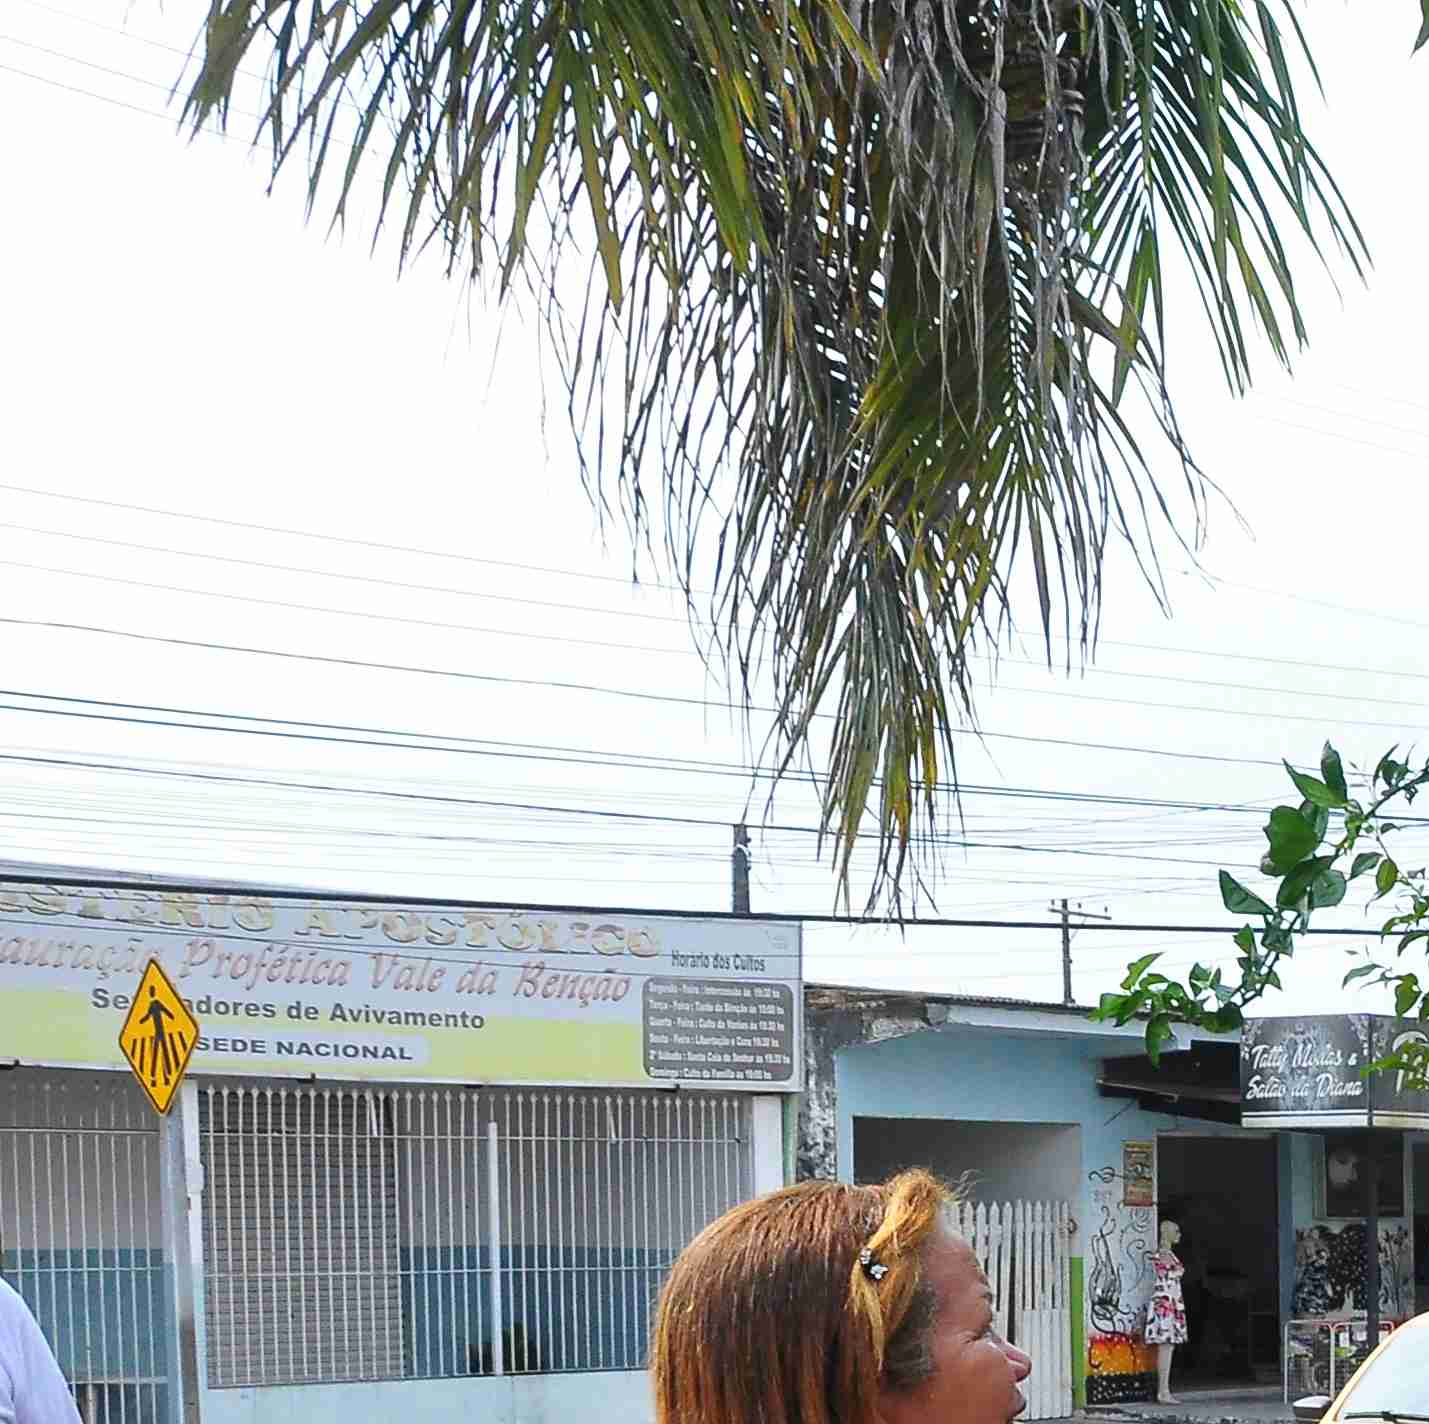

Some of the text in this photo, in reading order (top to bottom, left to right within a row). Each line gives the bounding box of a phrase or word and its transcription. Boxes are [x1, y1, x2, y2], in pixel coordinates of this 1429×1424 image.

[178, 936, 350, 990] Profética
[368, 952, 447, 993] Vale
[455, 961, 497, 995] da
[713, 953, 730, 970] dos
[91, 987, 485, 1029] Seadores de Avivamento
[196, 1036, 413, 1061] SEDE NACIONAL
[1315, 1073, 1364, 1099] Diana
